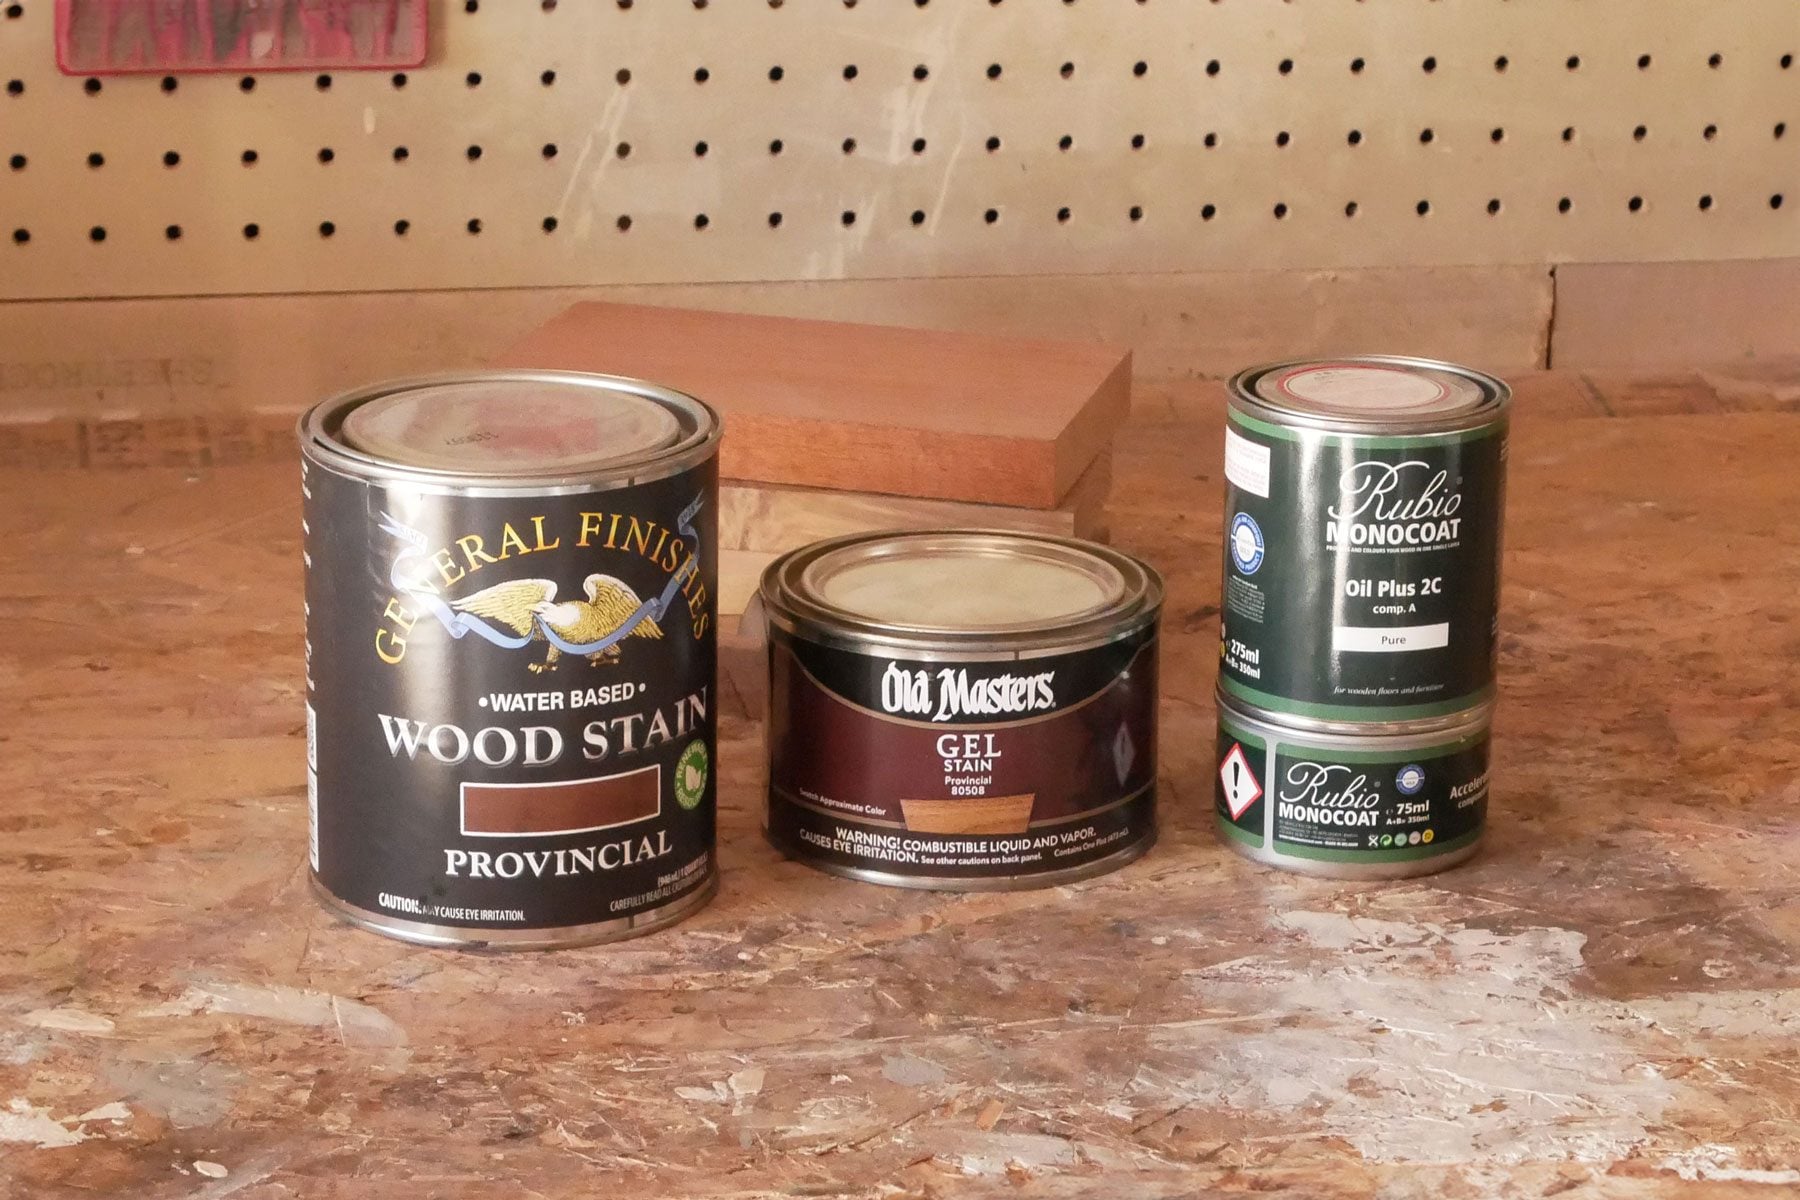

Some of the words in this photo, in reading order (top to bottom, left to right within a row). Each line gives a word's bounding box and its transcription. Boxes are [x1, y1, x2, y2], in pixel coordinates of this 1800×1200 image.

[1328, 461, 1461, 521] Rubio
[1326, 518, 1461, 545] MONOCOAT
[575, 512, 710, 640] FINISHES
[1346, 579, 1372, 597] Oil
[1378, 579, 1416, 598] Plus
[1421, 577, 1442, 595] 2C
[1373, 604, 1407, 615] comp.
[1408, 603, 1416, 613] A
[1231, 639, 1259, 664] 275ml
[1381, 635, 1407, 645] Pure
[1239, 662, 1261, 680] 350ml
[490, 691, 564, 712] WATER
[570, 682, 635, 709] BASED
[882, 661, 932, 714] Old
[932, 668, 1055, 722] Masters
[1334, 685, 1346, 694] for
[1347, 687, 1377, 695] wooden
[1377, 687, 1399, 696] floors
[1401, 686, 1415, 694] and
[378, 714, 564, 767] WOOD
[582, 685, 708, 761] STAIN
[936, 733, 1001, 759] GEL
[944, 759, 992, 773] STAIN
[945, 775, 992, 785] Provincial
[951, 785, 985, 796] 80508
[1279, 762, 1380, 809] Rubio
[820, 796, 864, 813] Approximate
[865, 805, 887, 816] Color
[1278, 801, 1379, 827] MONOCOAT
[1396, 799, 1430, 815] 75ml
[799, 828, 831, 849] CAUSES
[833, 840, 852, 854] EYE
[853, 844, 919, 864] IRRITATION.
[920, 855, 935, 865] See
[935, 855, 957, 866] other
[957, 855, 990, 866] cautions
[991, 857, 1001, 865] on
[1002, 854, 1020, 865] back
[1021, 852, 1043, 864] panel.
[836, 826, 901, 850] WARNING!
[903, 838, 987, 855] COMBUSTIBLE
[990, 838, 1031, 854] LIQUID
[1033, 832, 1059, 849] AND
[1060, 826, 1097, 844] VAPOR.
[1054, 846, 1082, 857] Contains
[445, 830, 673, 878] PROVINCIAL
[441, 907, 465, 919] CAUSE
[465, 909, 480, 920] EYE
[480, 910, 526, 922] IRRITATION.
